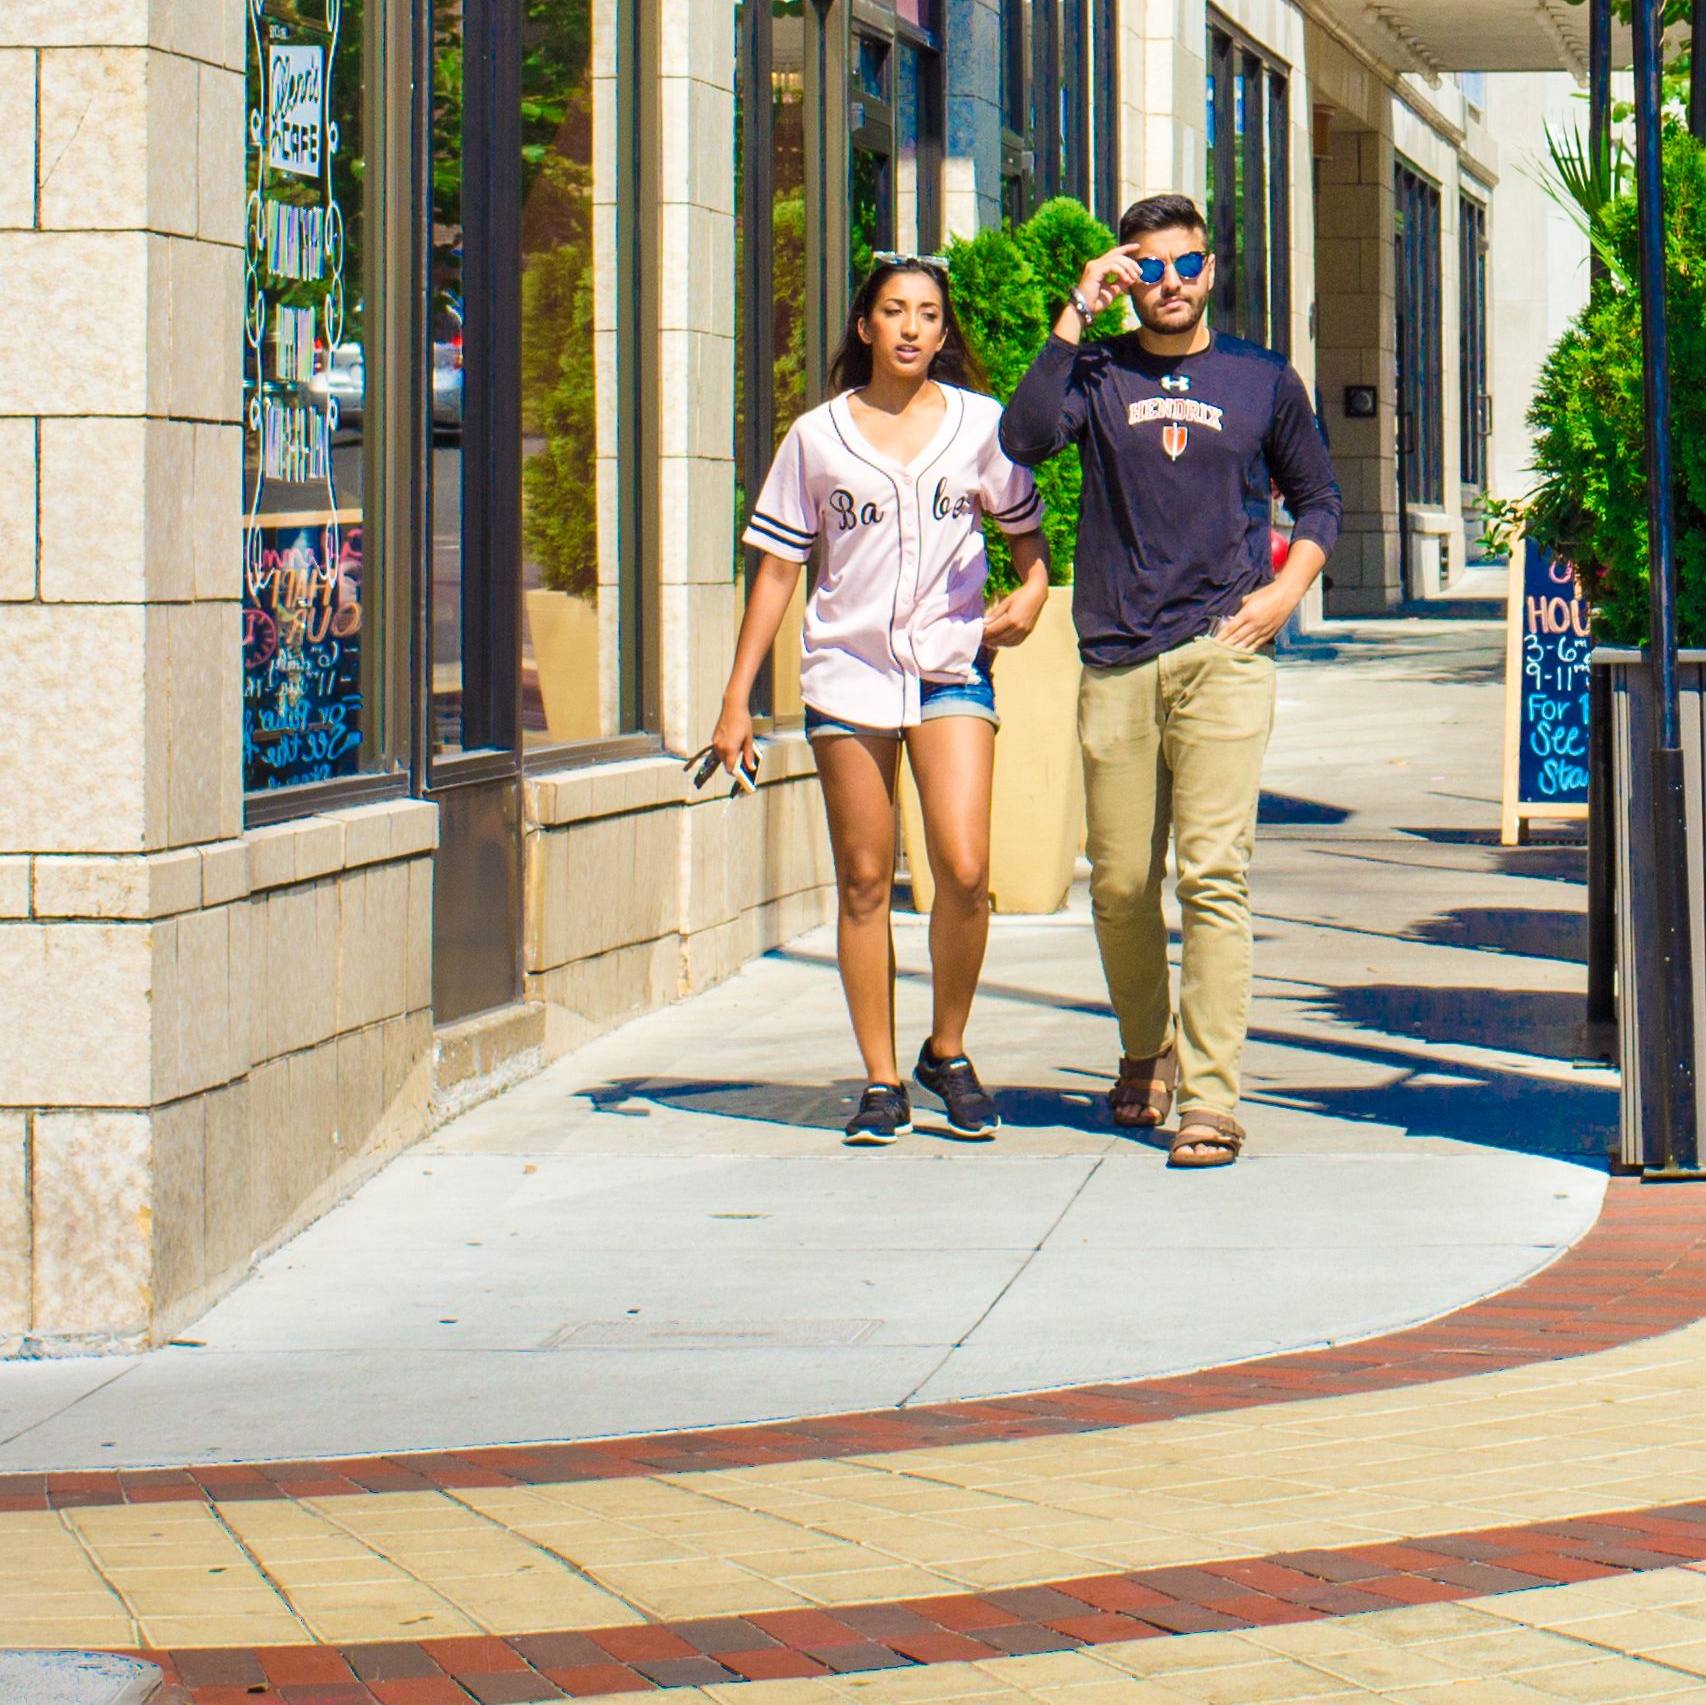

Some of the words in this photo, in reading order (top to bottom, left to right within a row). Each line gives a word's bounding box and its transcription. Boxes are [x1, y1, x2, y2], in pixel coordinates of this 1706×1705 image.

[1128, 397, 1223, 431] HENDRIX
[830, 489, 884, 530] Ba
[932, 476, 972, 521] be
[1527, 595, 1591, 637] HOU
[1528, 693, 1570, 722] For
[1530, 720, 1585, 756] See
[1538, 758, 1590, 795] Sta
